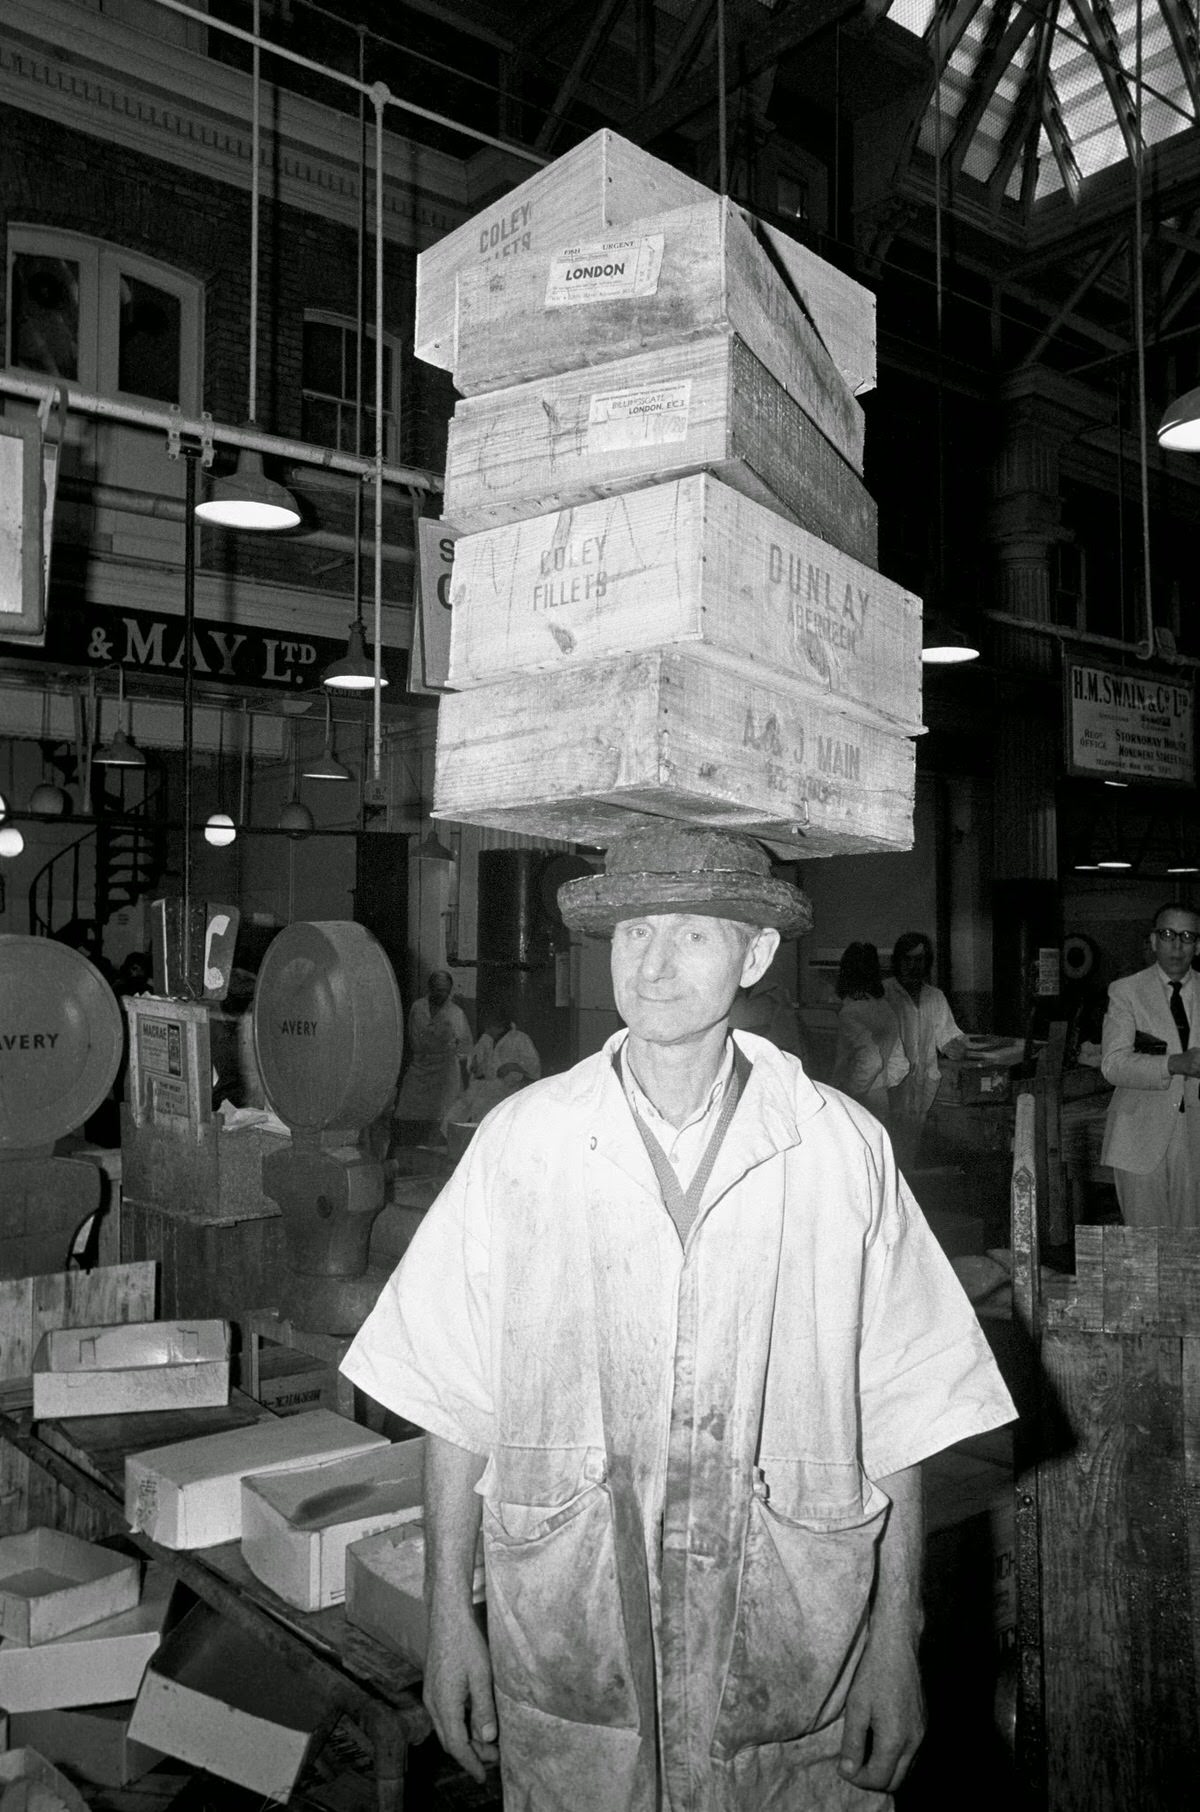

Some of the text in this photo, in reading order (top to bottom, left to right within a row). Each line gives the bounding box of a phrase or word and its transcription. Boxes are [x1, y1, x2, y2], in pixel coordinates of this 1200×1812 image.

[480, 201, 530, 253] COLEY
[602, 240, 635, 250] URGENT
[565, 262, 625, 281] LONDON
[541, 534, 606, 576] COLEY
[533, 571, 607, 611] FILLETS
[769, 543, 869, 630] DUNLAY
[87, 627, 114, 660] &
[121, 618, 247, 675] MAY
[818, 735, 860, 781] MAIN
[281, 1020, 318, 1036] AVERY
